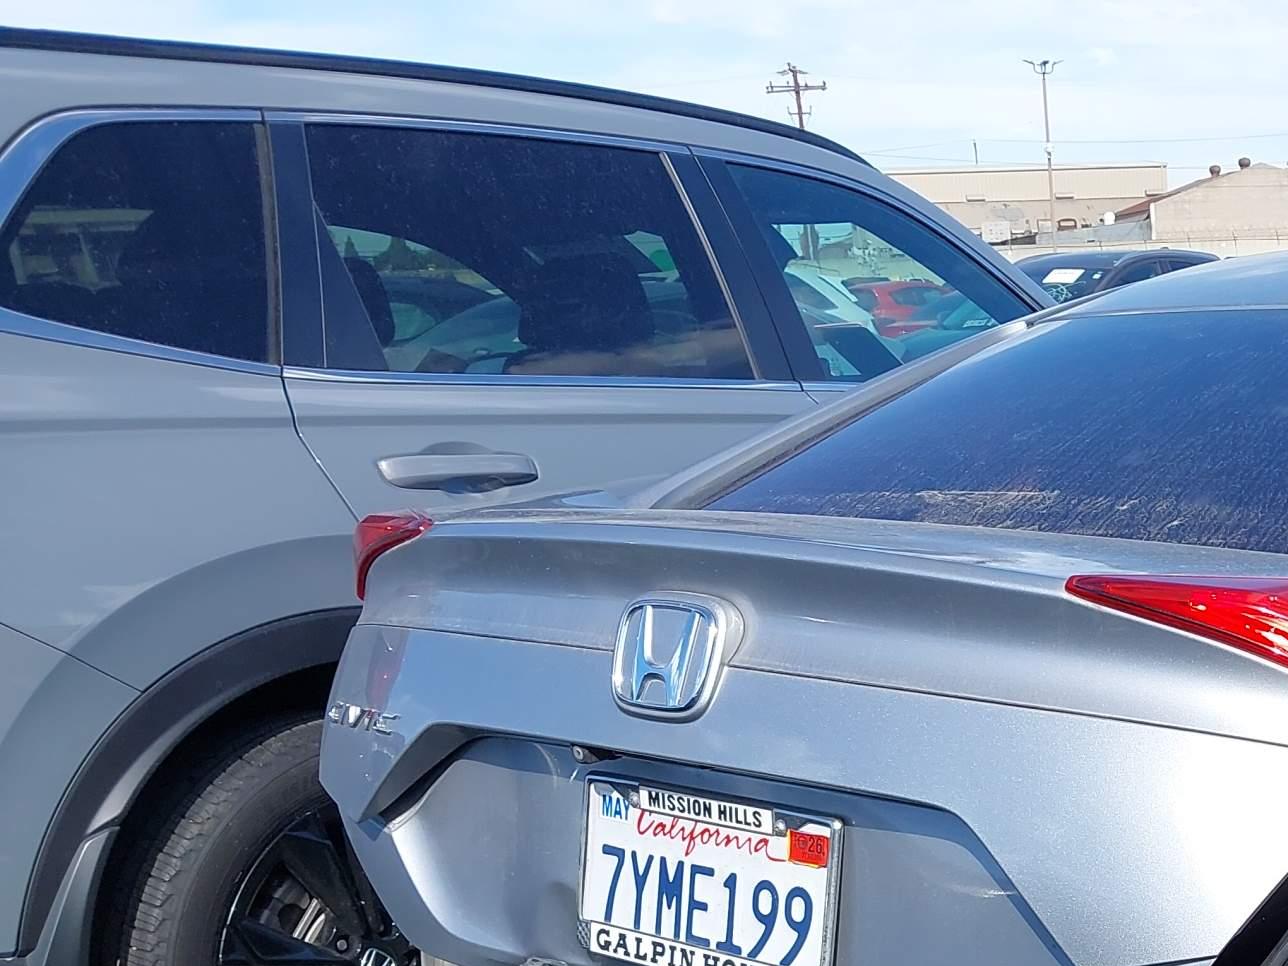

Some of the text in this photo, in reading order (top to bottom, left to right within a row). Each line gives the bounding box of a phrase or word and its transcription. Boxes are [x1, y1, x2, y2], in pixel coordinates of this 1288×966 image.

[602, 794, 631, 821] MAY
[647, 790, 763, 829] MISSION HILLS
[637, 810, 787, 862] California
[601, 843, 814, 966] 7YME199
